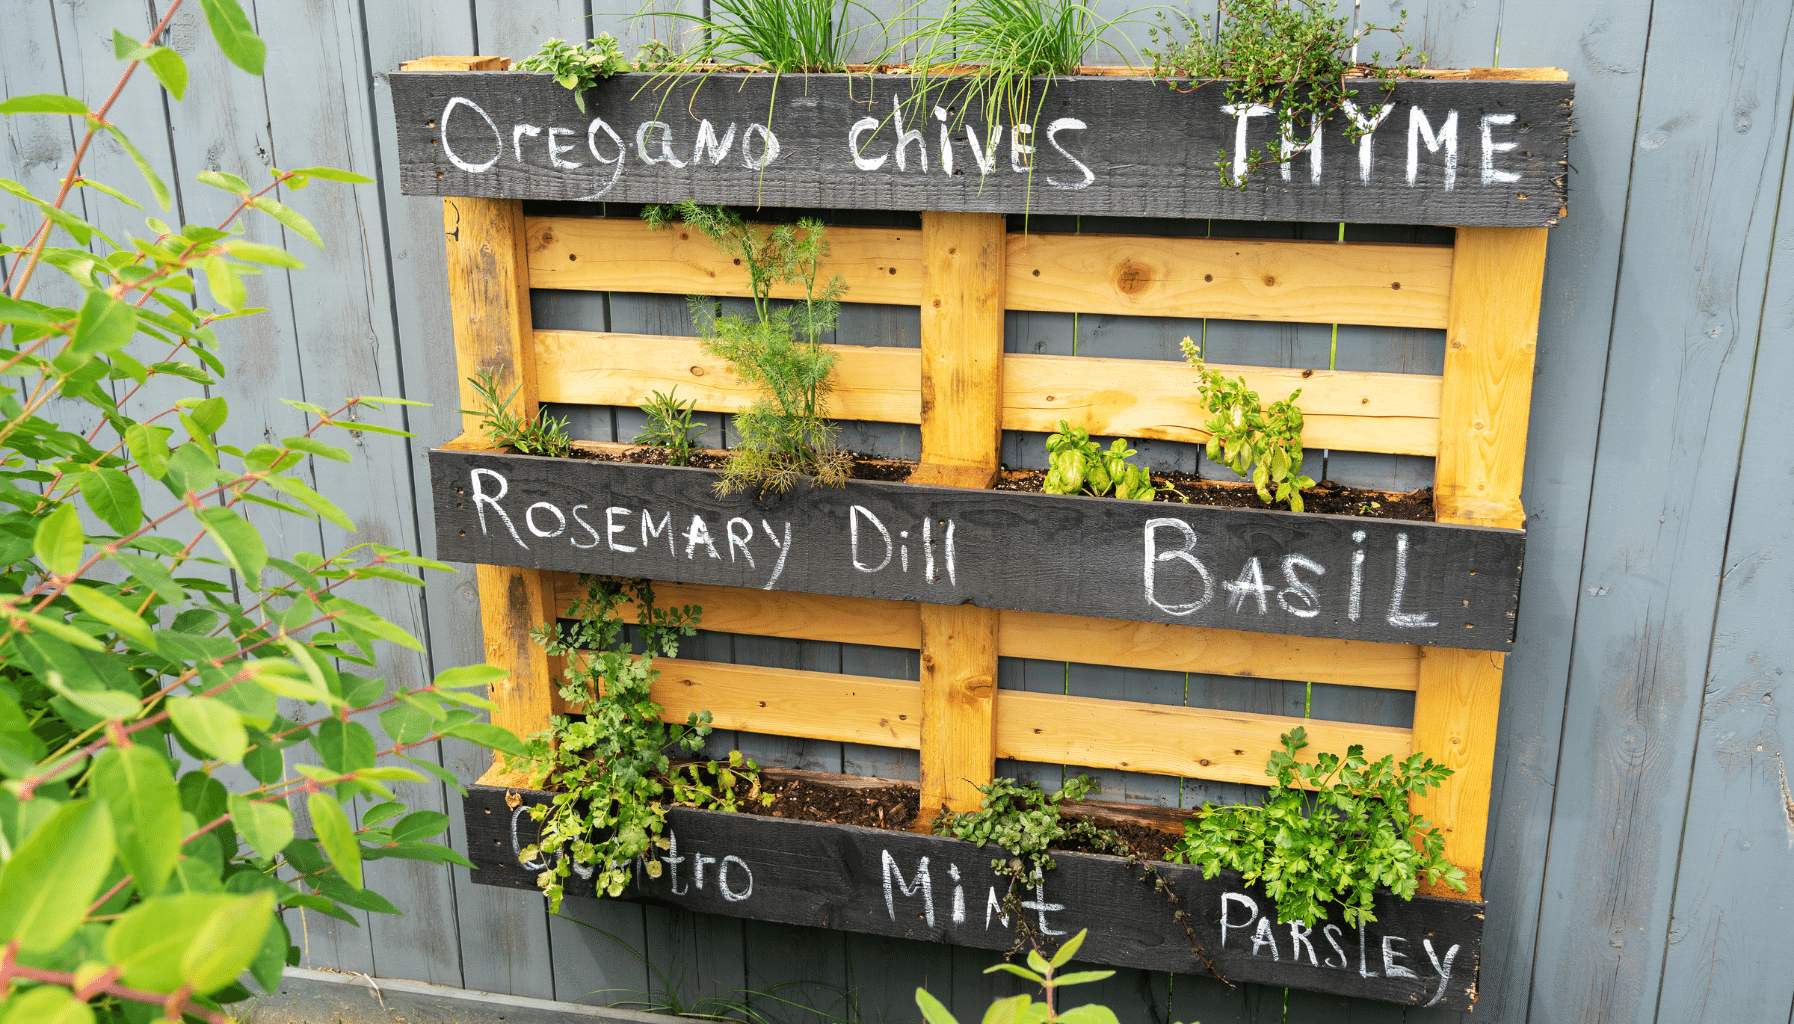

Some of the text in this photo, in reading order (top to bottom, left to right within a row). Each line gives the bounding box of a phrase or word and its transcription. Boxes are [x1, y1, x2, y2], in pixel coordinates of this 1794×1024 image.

[1220, 99, 1523, 191] THYME
[850, 505, 957, 587] Dill
[1220, 892, 1460, 1007] PARSLEY
